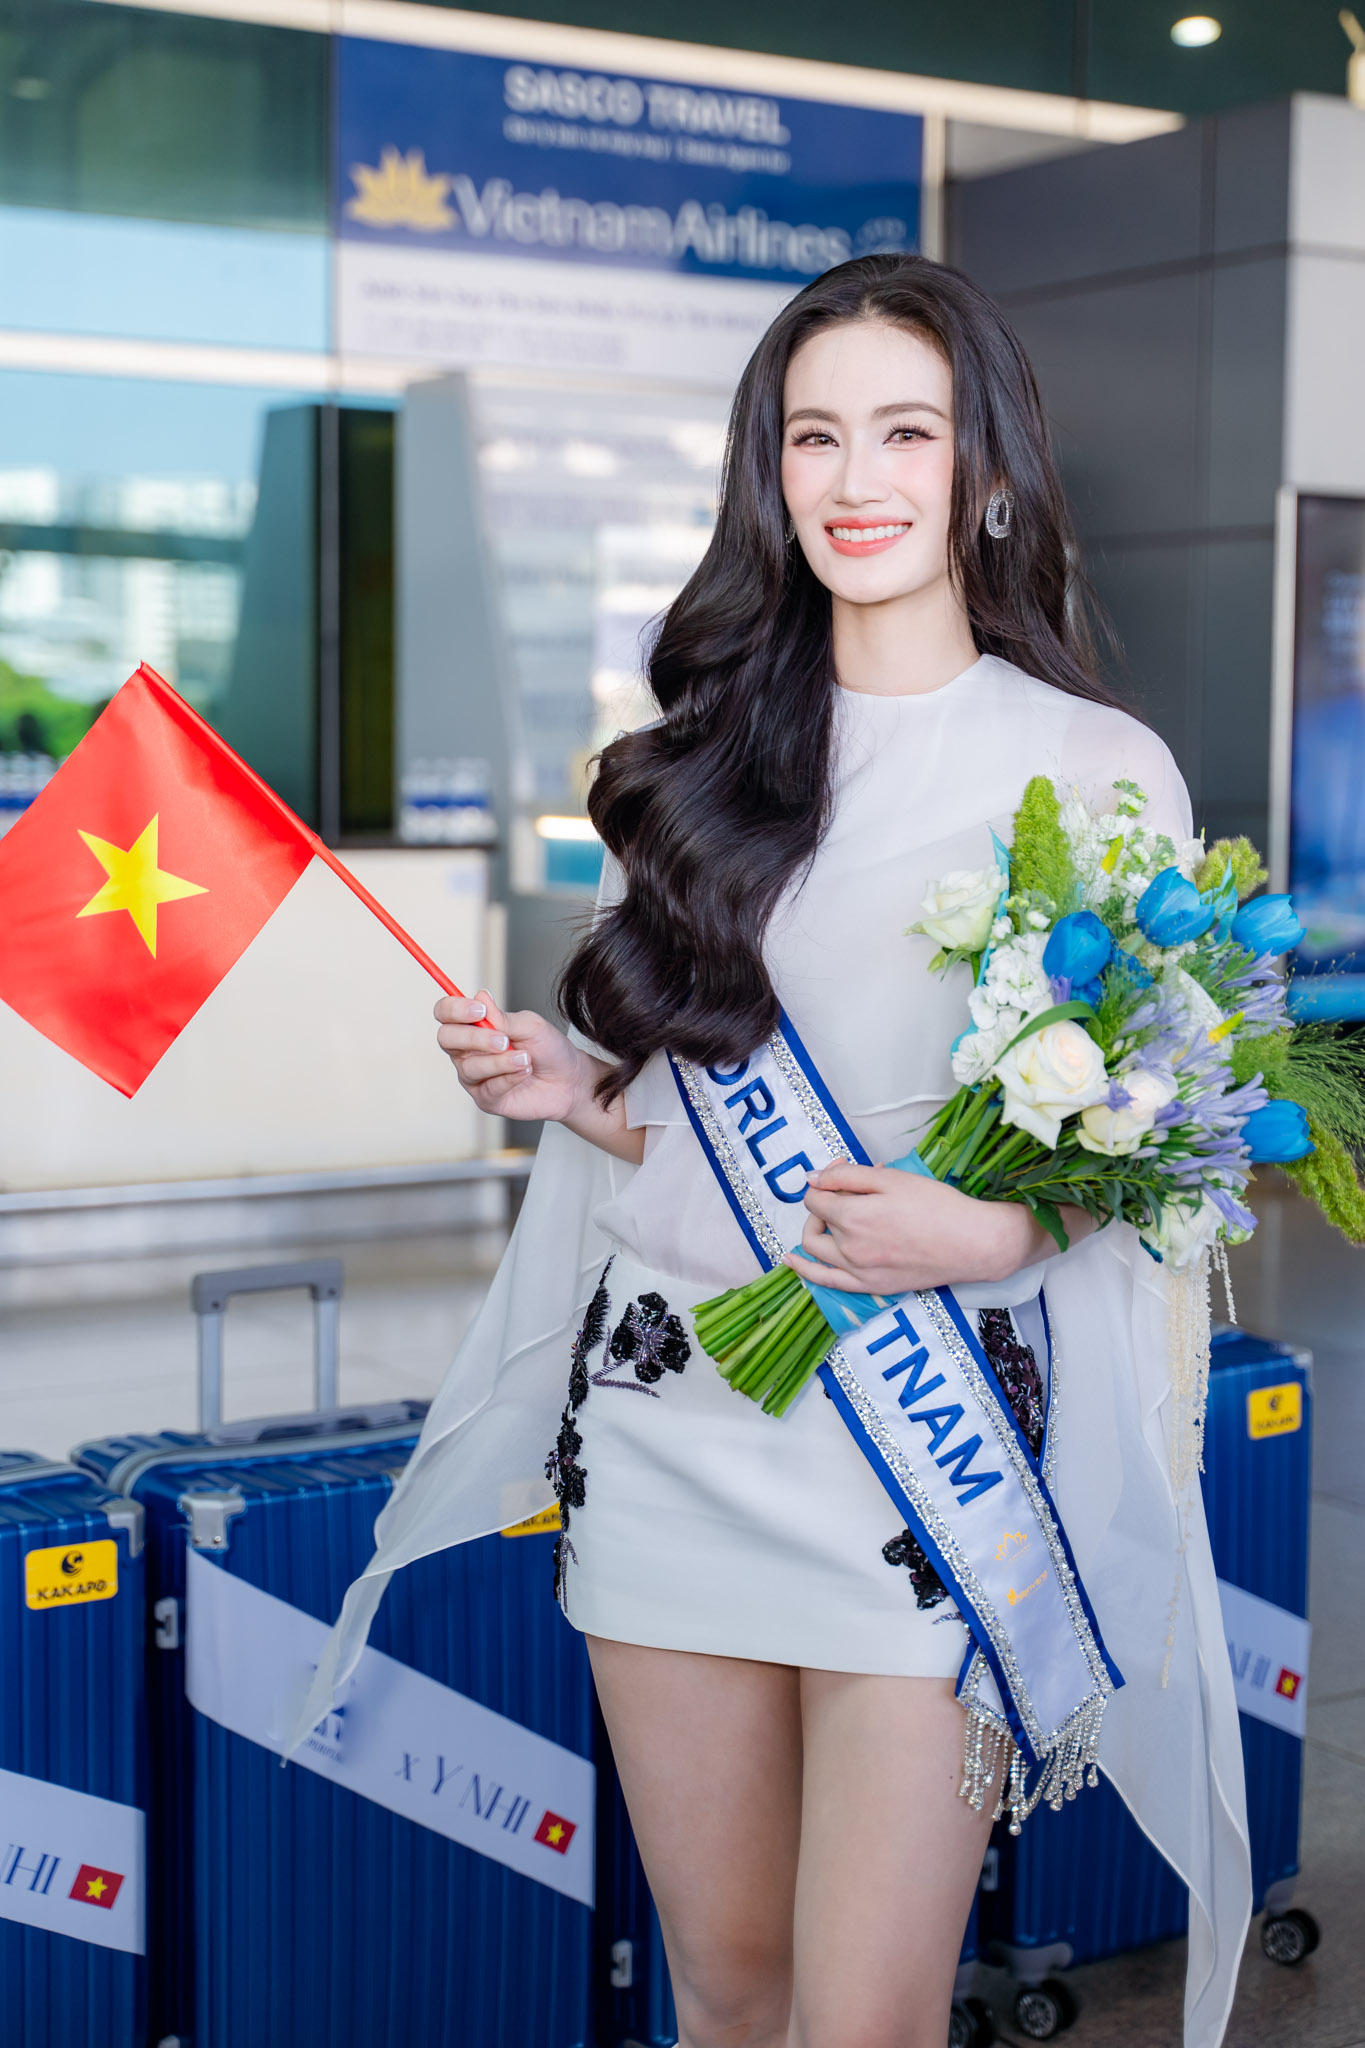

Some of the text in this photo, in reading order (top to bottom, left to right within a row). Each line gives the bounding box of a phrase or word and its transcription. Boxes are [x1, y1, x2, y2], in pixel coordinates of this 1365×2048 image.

[503, 65, 644, 126] SASCO
[646, 84, 791, 145] TRAVEL
[866, 1306, 1005, 1507] TNAM
[37, 1579, 107, 1602] KAKAPO
